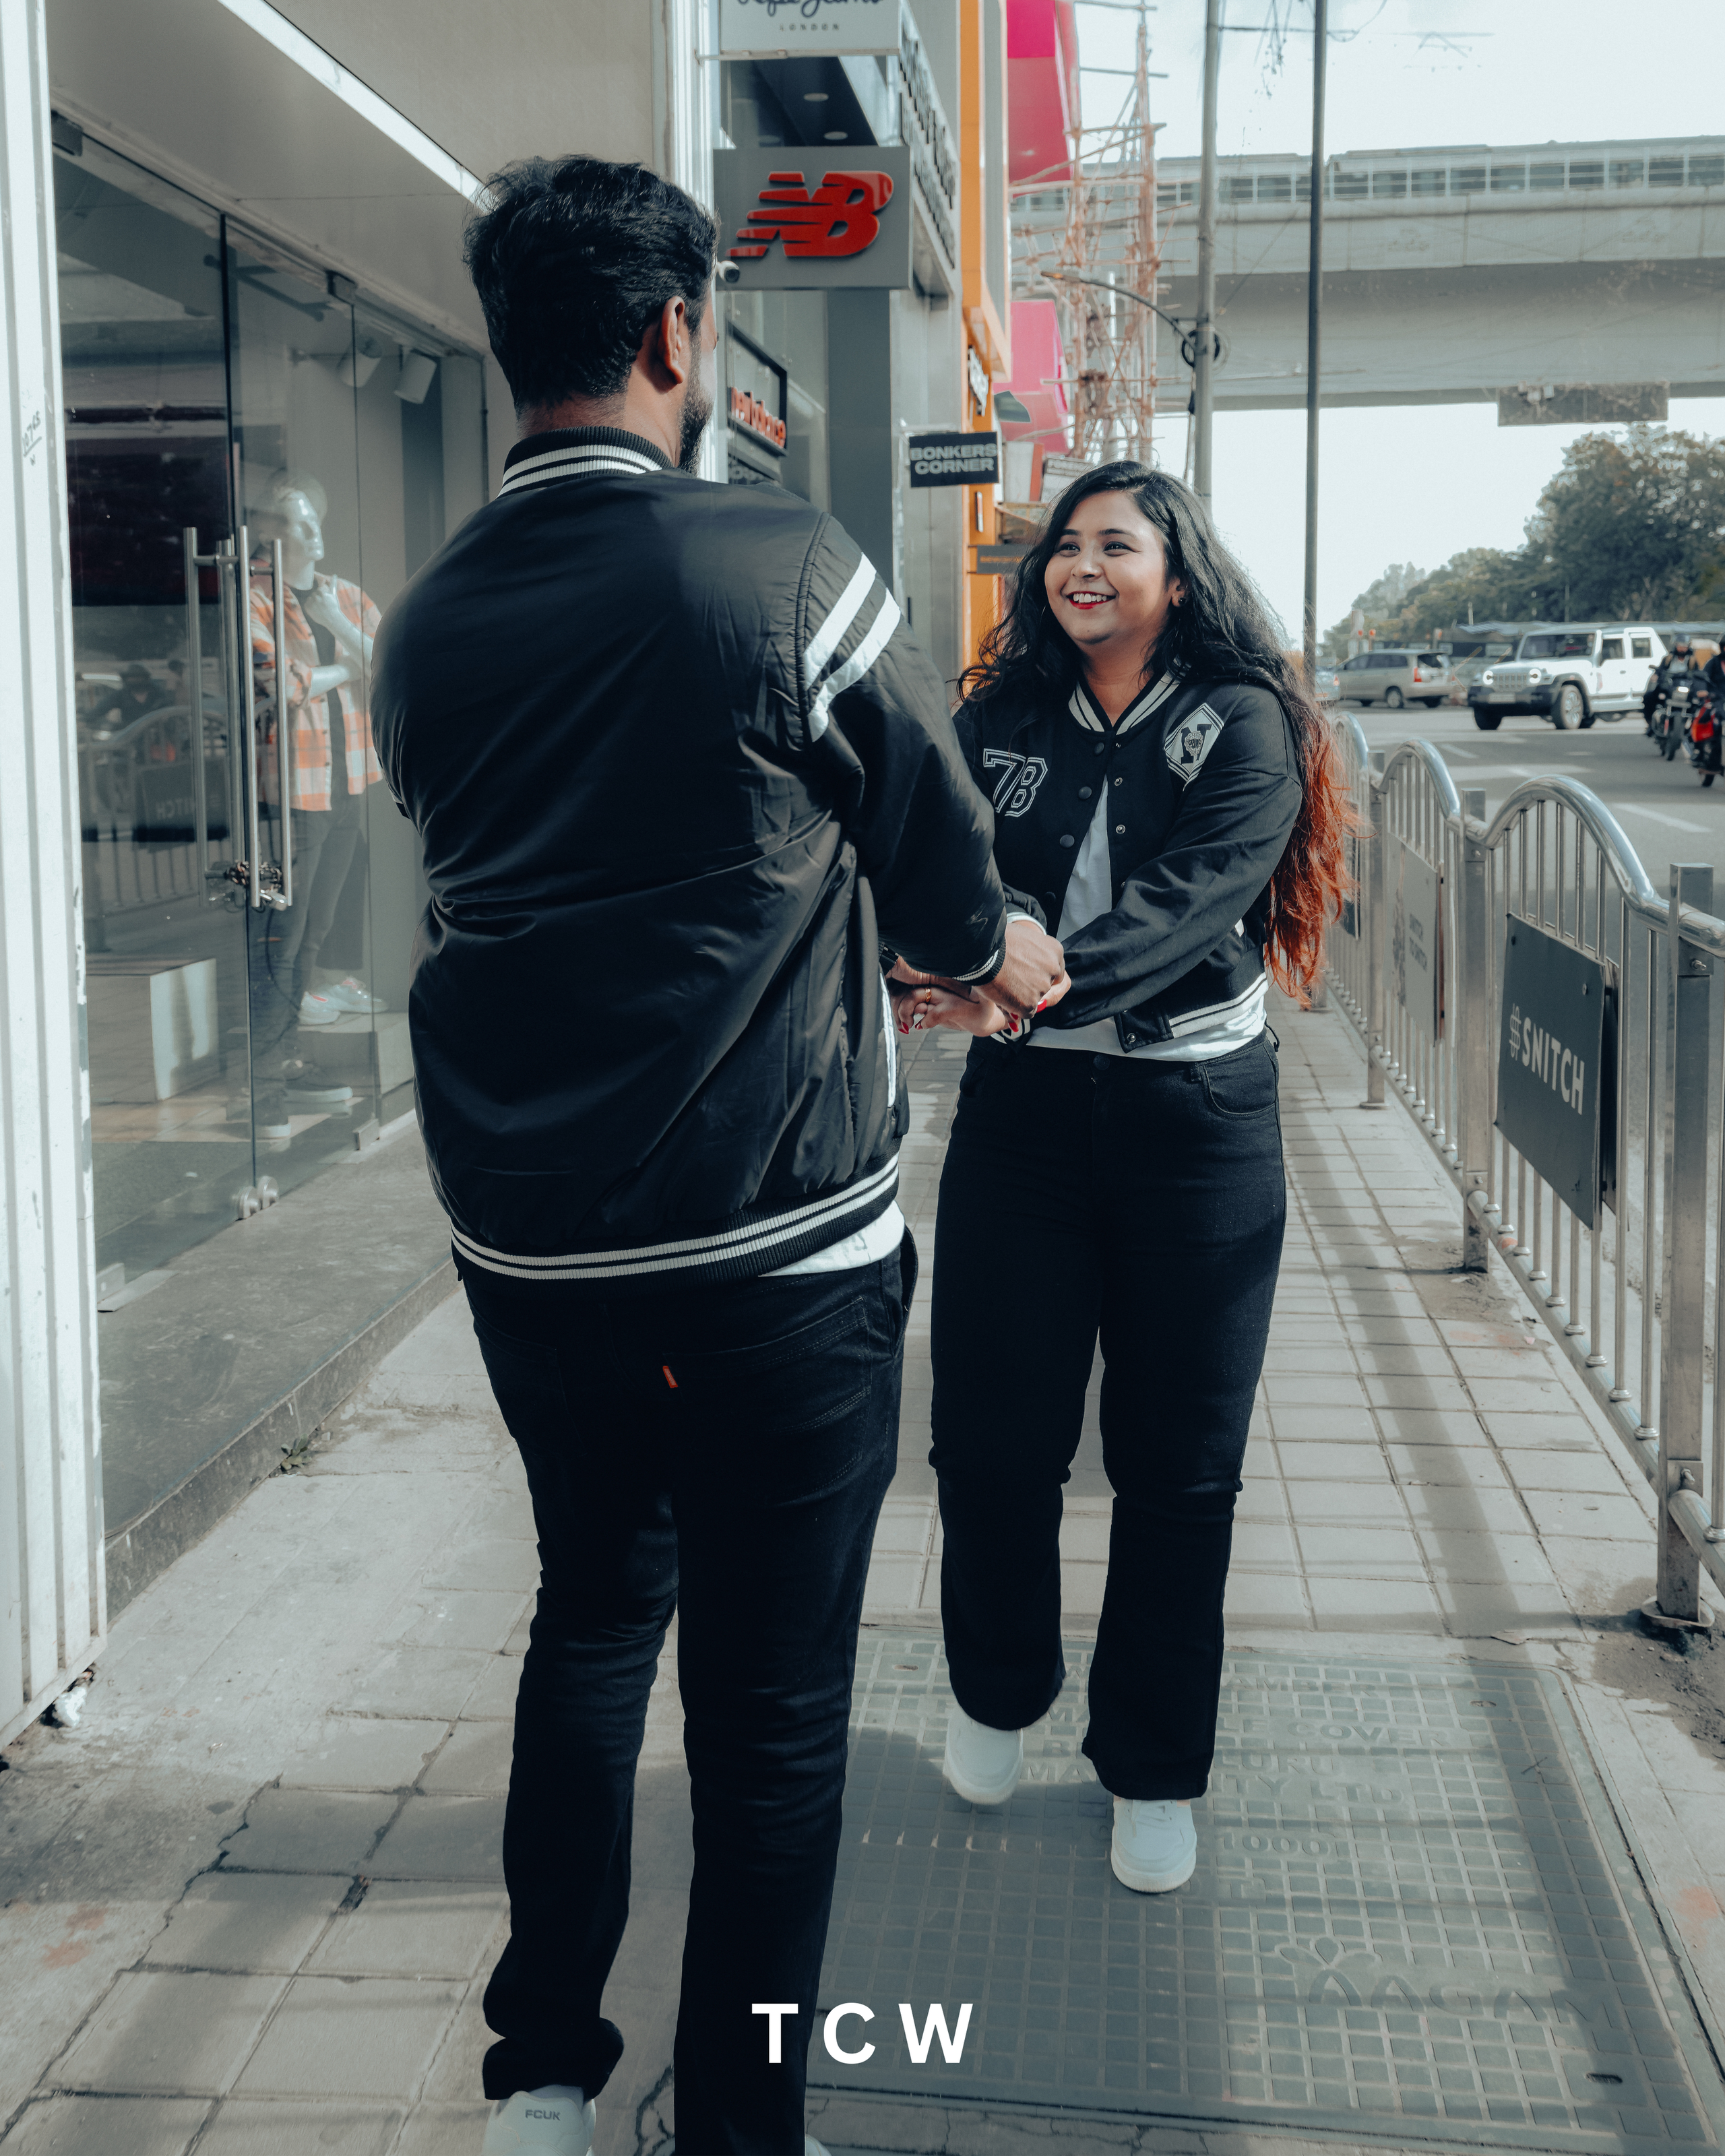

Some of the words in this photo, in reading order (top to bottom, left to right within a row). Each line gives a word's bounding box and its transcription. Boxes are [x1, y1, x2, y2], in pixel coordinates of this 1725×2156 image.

[780, 23, 840, 32] LONDON
[910, 443, 997, 461] BONKERS
[915, 457, 994, 474] CORNER
[983, 748, 1048, 818] 78
[1522, 1017, 1585, 1116] SNITCH
[1288, 1720, 1450, 1746] COVER
[1310, 1780, 1403, 1803] LTD
[526, 2110, 561, 2121] FCUK
